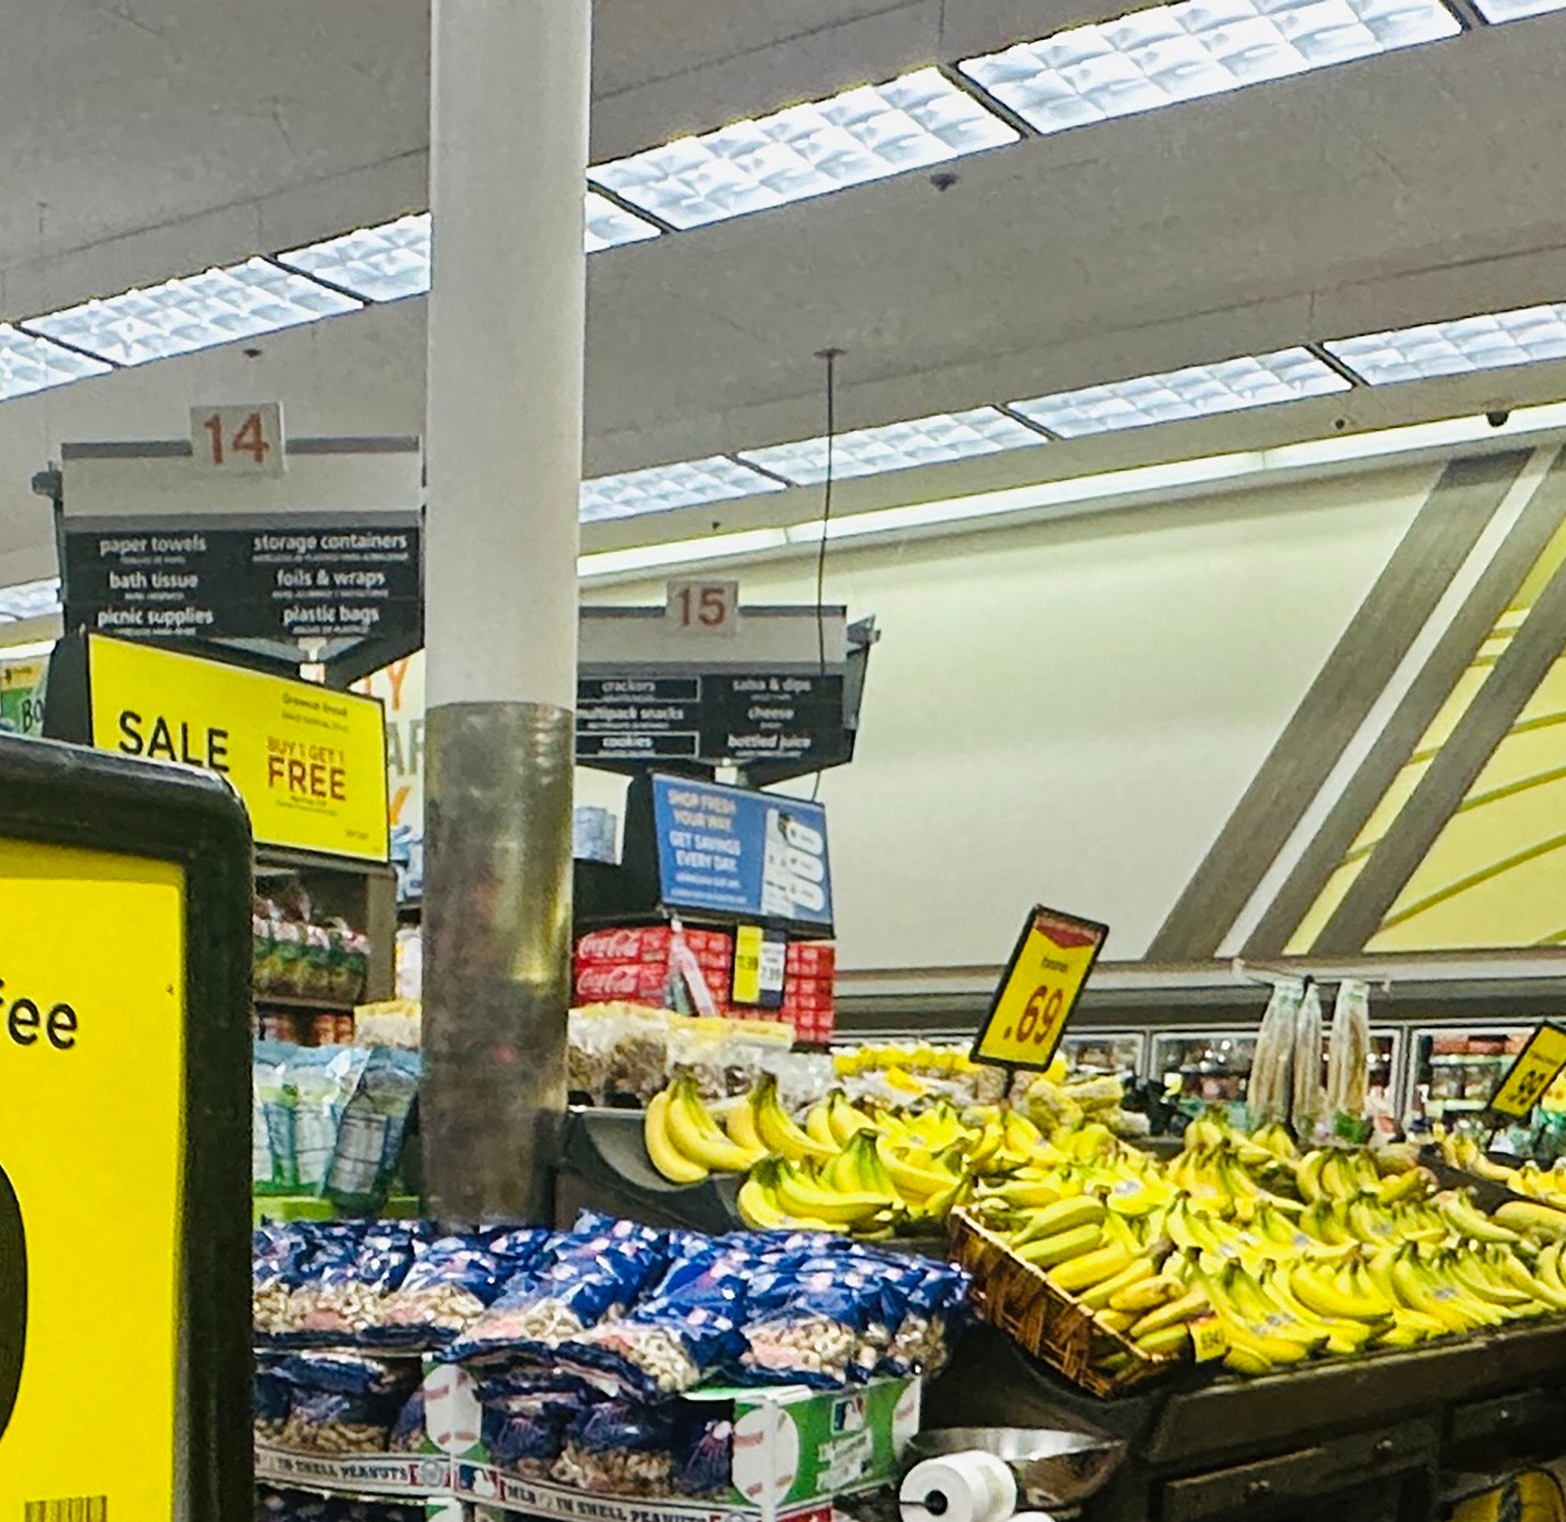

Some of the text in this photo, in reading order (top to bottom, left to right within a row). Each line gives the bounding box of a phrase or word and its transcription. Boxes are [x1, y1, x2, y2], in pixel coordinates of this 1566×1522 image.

[204, 412, 269, 465] 14
[99, 533, 207, 556] paper towels
[253, 532, 408, 554] storage containers
[109, 570, 199, 589] bath tissue
[276, 569, 386, 591] foils & wraps
[97, 607, 215, 627] picnic supplies
[283, 604, 381, 627] plastic bags
[680, 587, 726, 628] 15
[119, 709, 230, 774] SALE
[267, 755, 347, 802] FREE
[556, 1496, 575, 1513] IN
